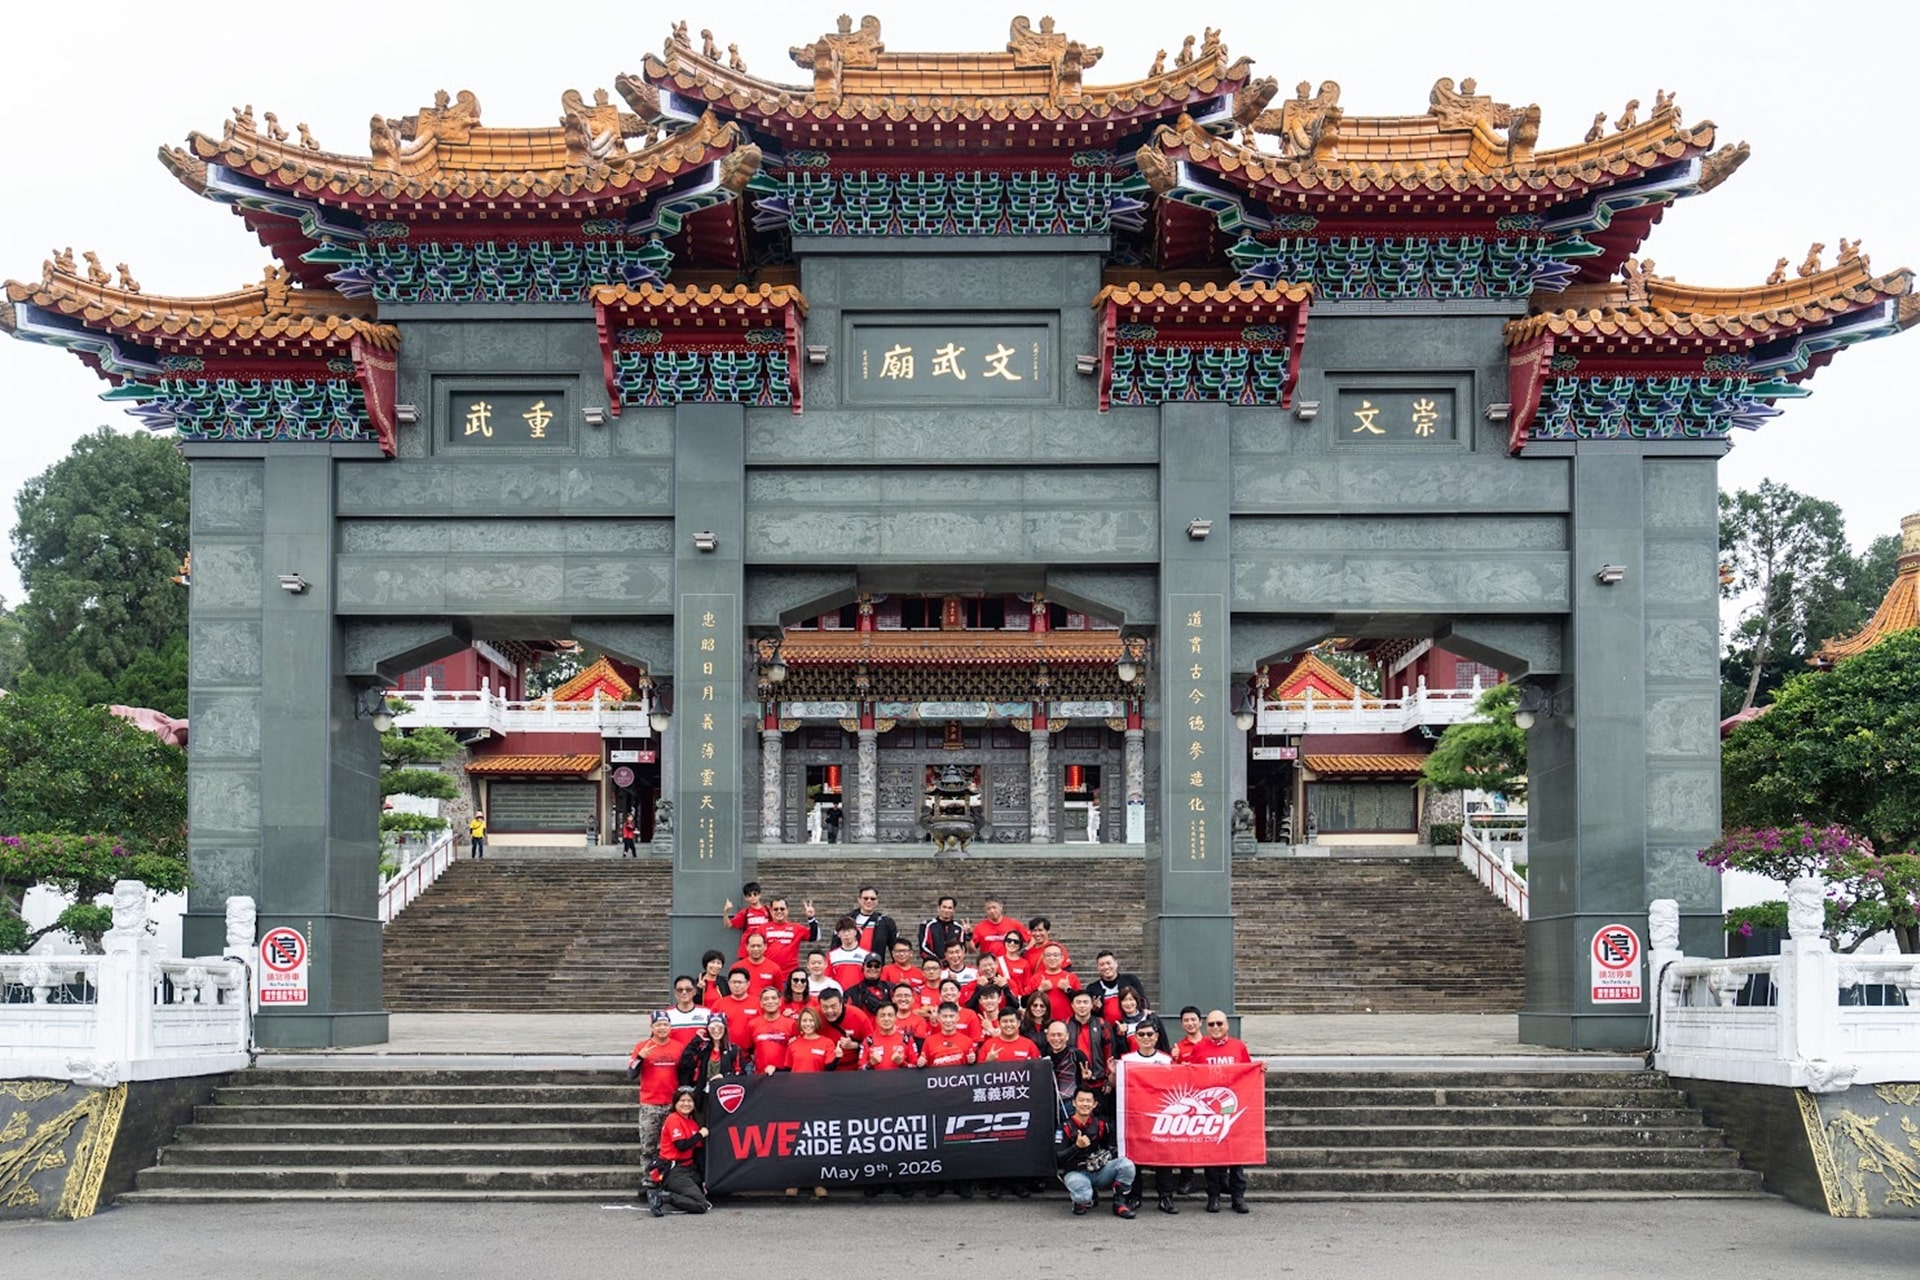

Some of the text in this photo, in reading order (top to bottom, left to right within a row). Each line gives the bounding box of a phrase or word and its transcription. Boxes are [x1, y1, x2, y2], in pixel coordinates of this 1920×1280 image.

[879, 342, 1022, 381] 文武廟
[464, 400, 553, 438] 重武
[1352, 398, 1439, 437] 崇文
[270, 937, 297, 963] 停
[1602, 934, 1630, 961] 停
[1206, 1056, 1235, 1064] TIME
[927, 1070, 1030, 1089] DUCATI CHIAYI
[973, 1085, 1030, 1102] 嘉義碩文
[801, 1120, 841, 1137] ARE
[848, 1115, 927, 1136] DUCATI
[1146, 1108, 1248, 1144] DOCCY
[728, 1121, 800, 1160] WE
[794, 1138, 843, 1156] RIDE
[847, 1136, 876, 1155] AS
[879, 1133, 928, 1153] ONE
[820, 1166, 859, 1181] May
[898, 1160, 942, 1175] 2026
